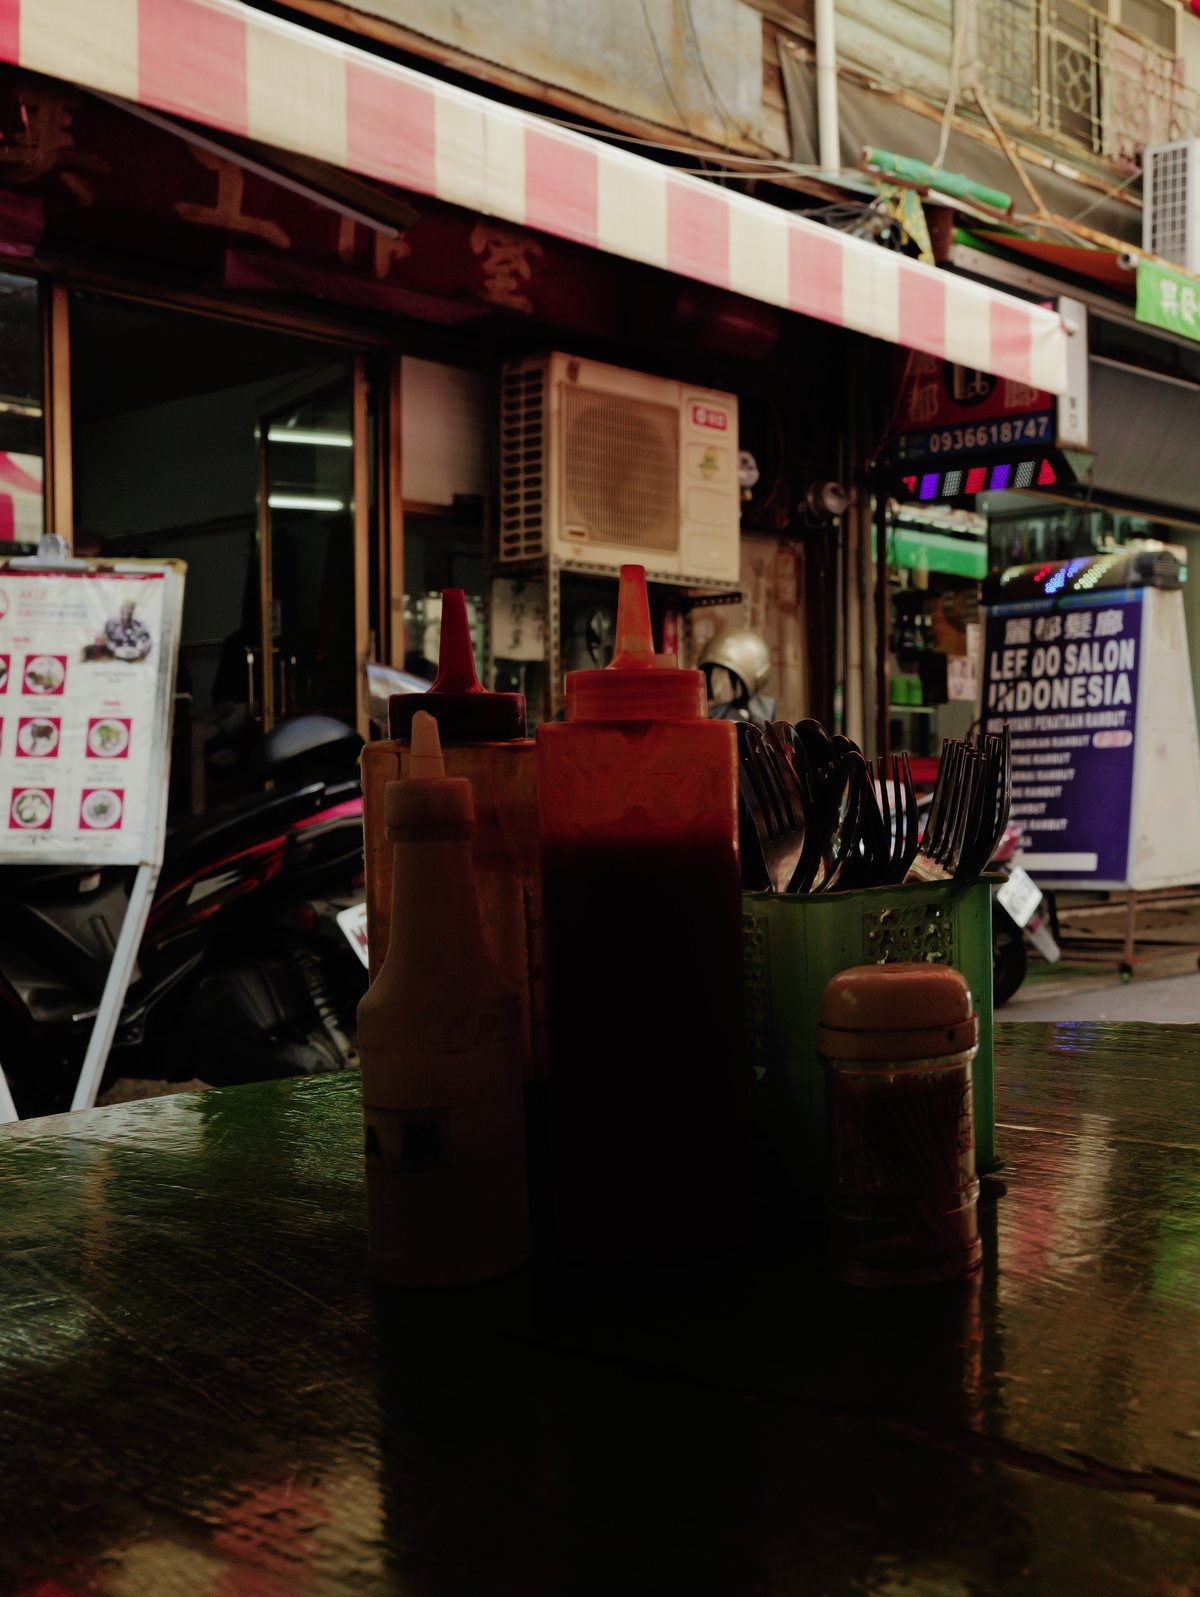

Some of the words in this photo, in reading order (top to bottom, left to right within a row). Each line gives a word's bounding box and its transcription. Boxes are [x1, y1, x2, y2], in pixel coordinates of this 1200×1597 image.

[929, 416, 1049, 453] 0936618747
[1004, 609, 1124, 645] 麗都髮廊
[1031, 645, 1061, 678] DO
[1064, 638, 1135, 675] SALON
[988, 673, 1132, 712] INDONESIA
